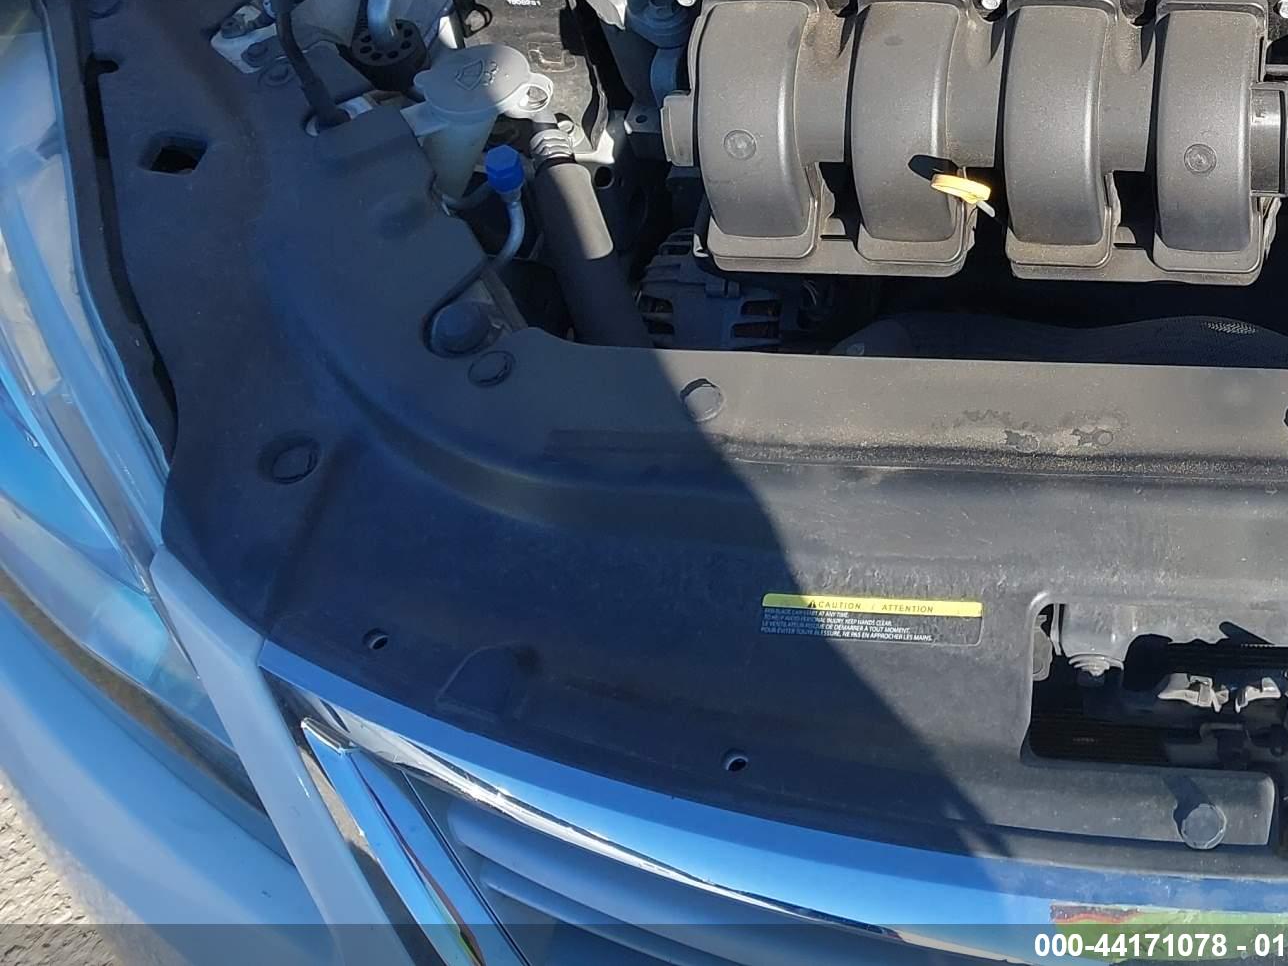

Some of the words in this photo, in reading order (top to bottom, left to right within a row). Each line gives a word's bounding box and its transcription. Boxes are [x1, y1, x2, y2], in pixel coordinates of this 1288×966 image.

[818, 601, 861, 610] CAUTION
[881, 604, 934, 613] ATTENTION
[870, 632, 903, 640] APPROCHER
